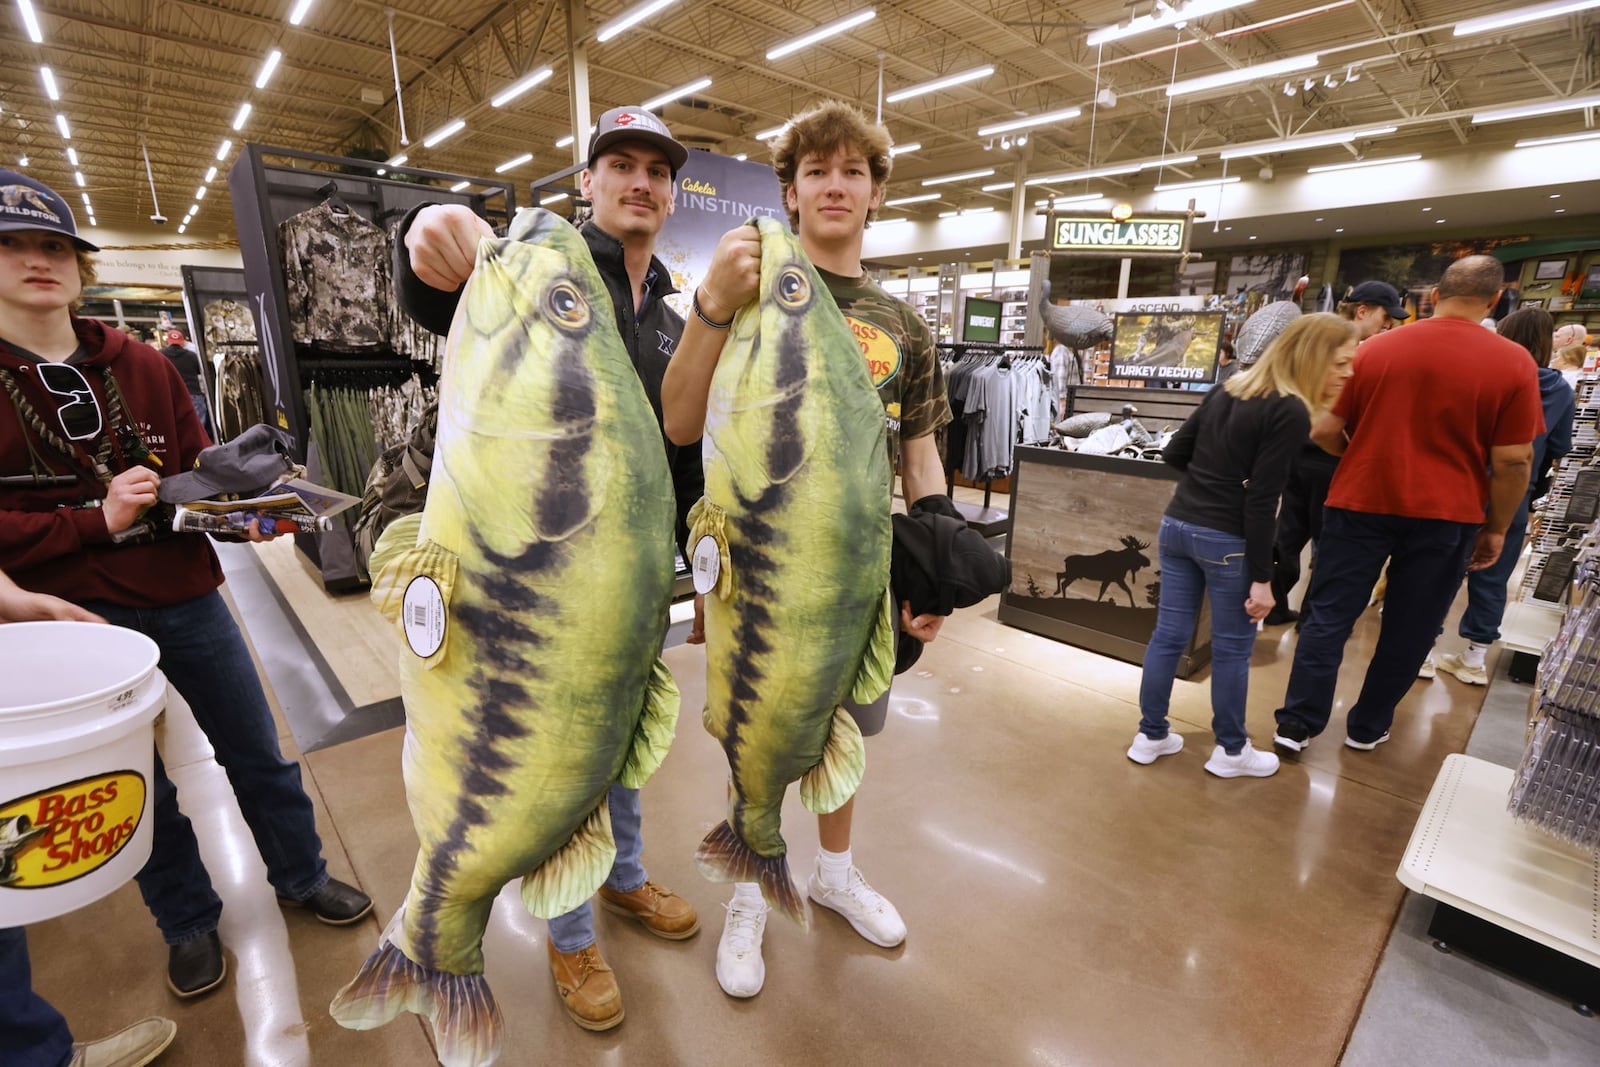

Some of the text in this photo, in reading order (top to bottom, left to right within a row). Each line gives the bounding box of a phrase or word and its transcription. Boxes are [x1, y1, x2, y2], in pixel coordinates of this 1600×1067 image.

[682, 193, 777, 218] INSTINCT
[1059, 222, 1179, 246] SUNGLASSES
[1131, 303, 1180, 313] ASCEND
[1115, 365, 1204, 379] TURKEY DECOYS
[34, 781, 118, 826] Bass
[38, 811, 104, 849] Pro
[42, 816, 134, 873] Shops
